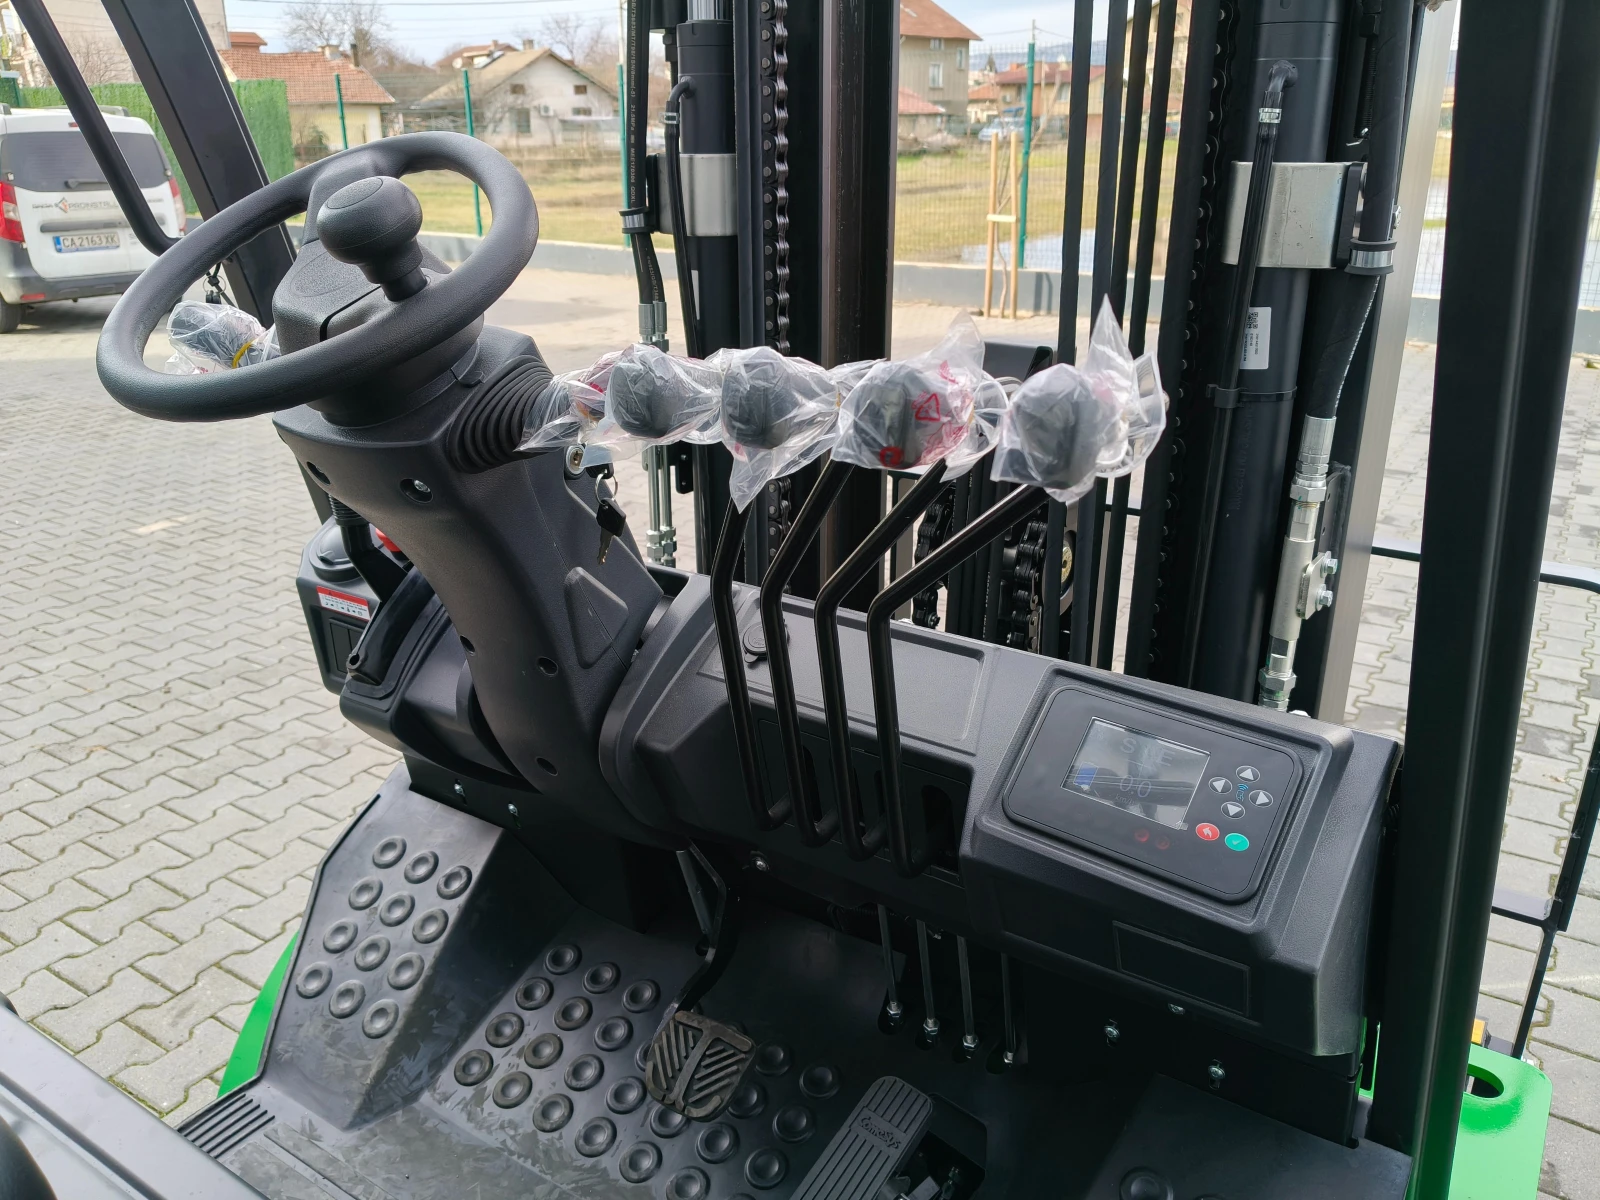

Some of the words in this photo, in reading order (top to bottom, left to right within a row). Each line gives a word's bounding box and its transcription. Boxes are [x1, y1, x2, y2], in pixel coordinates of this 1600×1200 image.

[62, 237, 76, 249] CA
[78, 236, 103, 247] 2163
[104, 234, 118, 245] XK
[1119, 774, 1152, 798] 0.0
